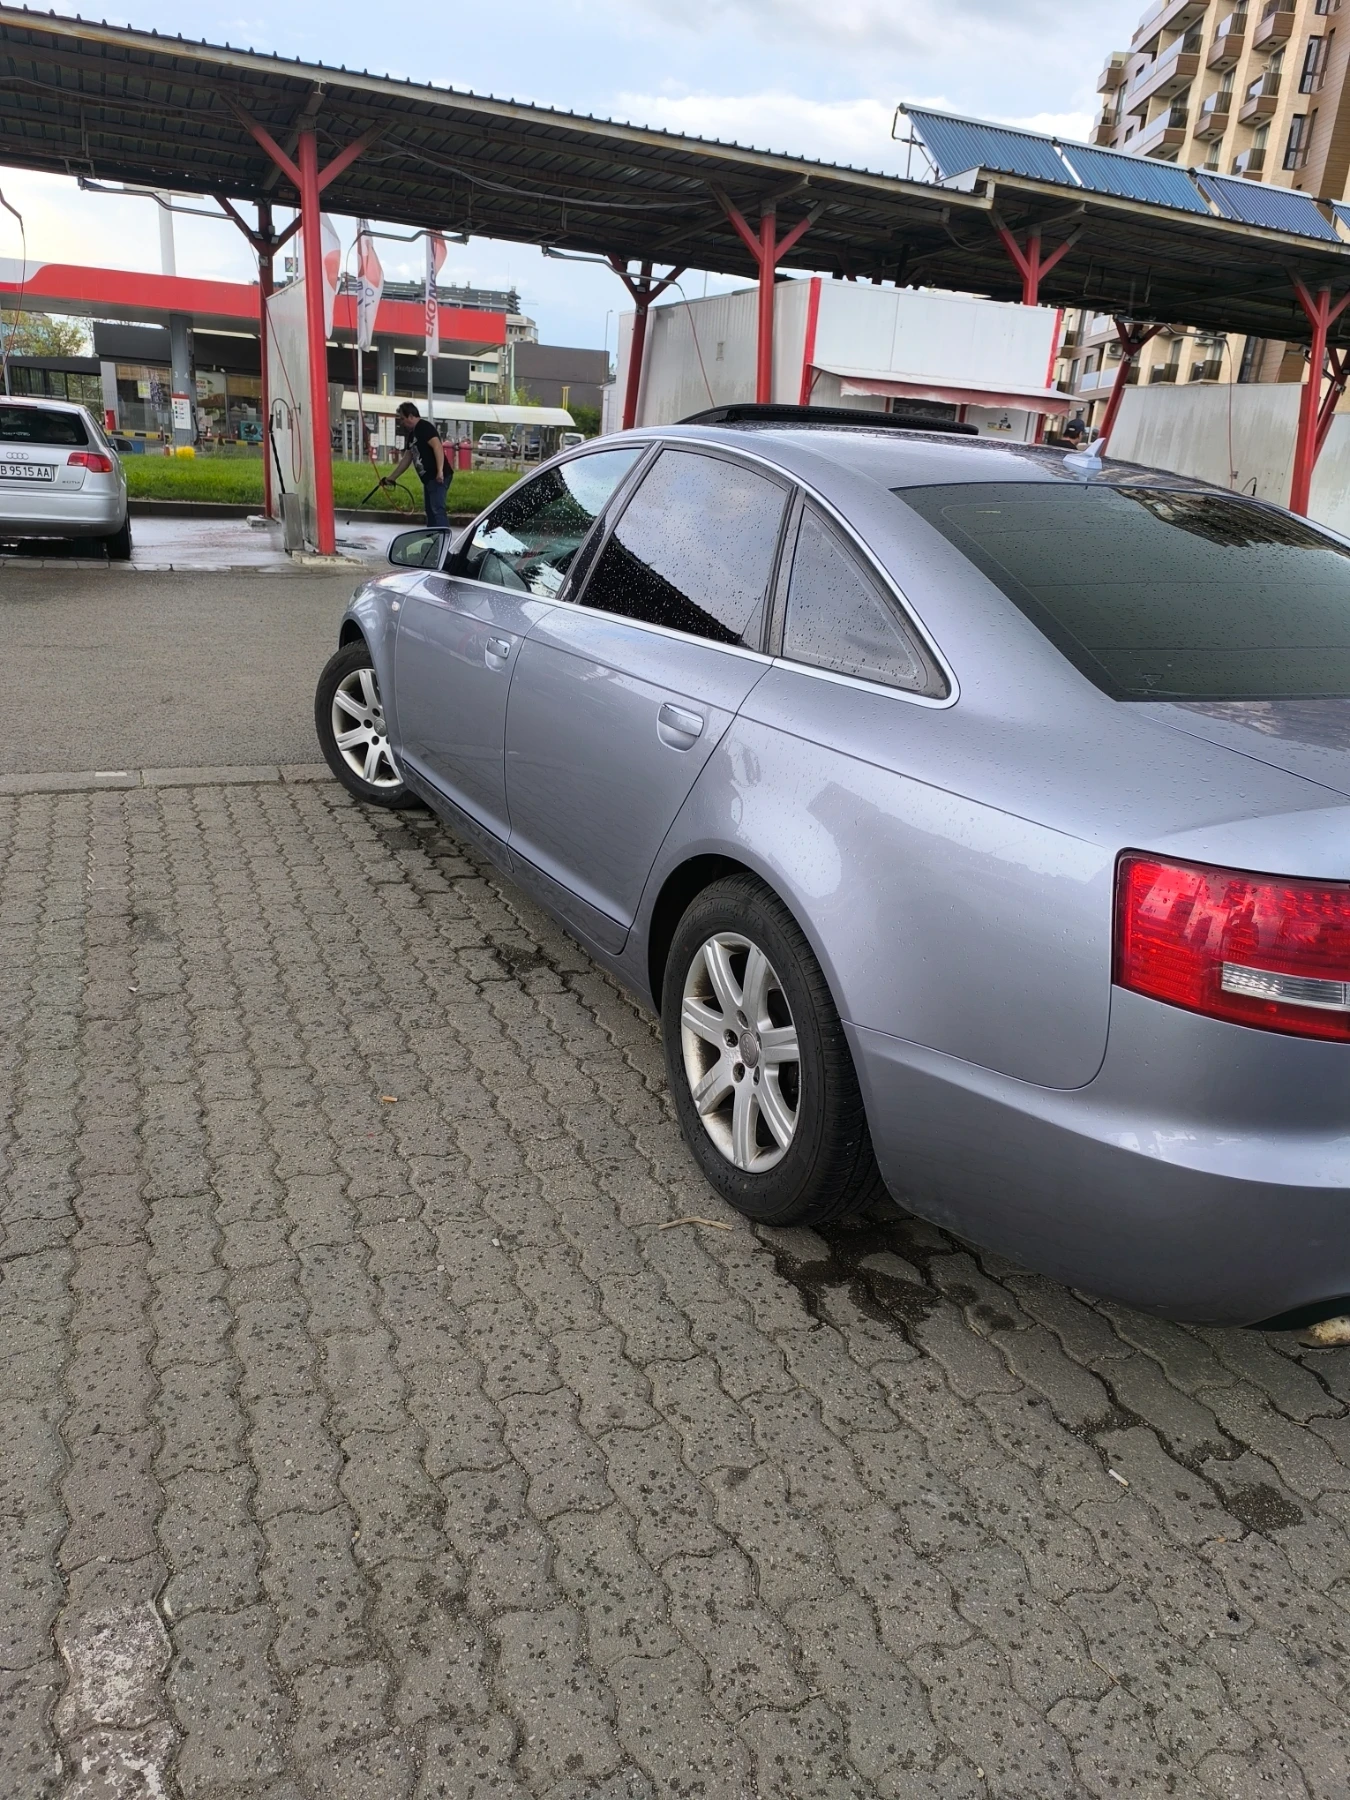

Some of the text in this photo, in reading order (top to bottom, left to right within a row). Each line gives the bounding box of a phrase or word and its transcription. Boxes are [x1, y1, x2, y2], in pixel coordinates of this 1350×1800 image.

[174, 371, 179, 379] 3
[9, 465, 34, 476] 9515
[36, 467, 50, 477] AA
